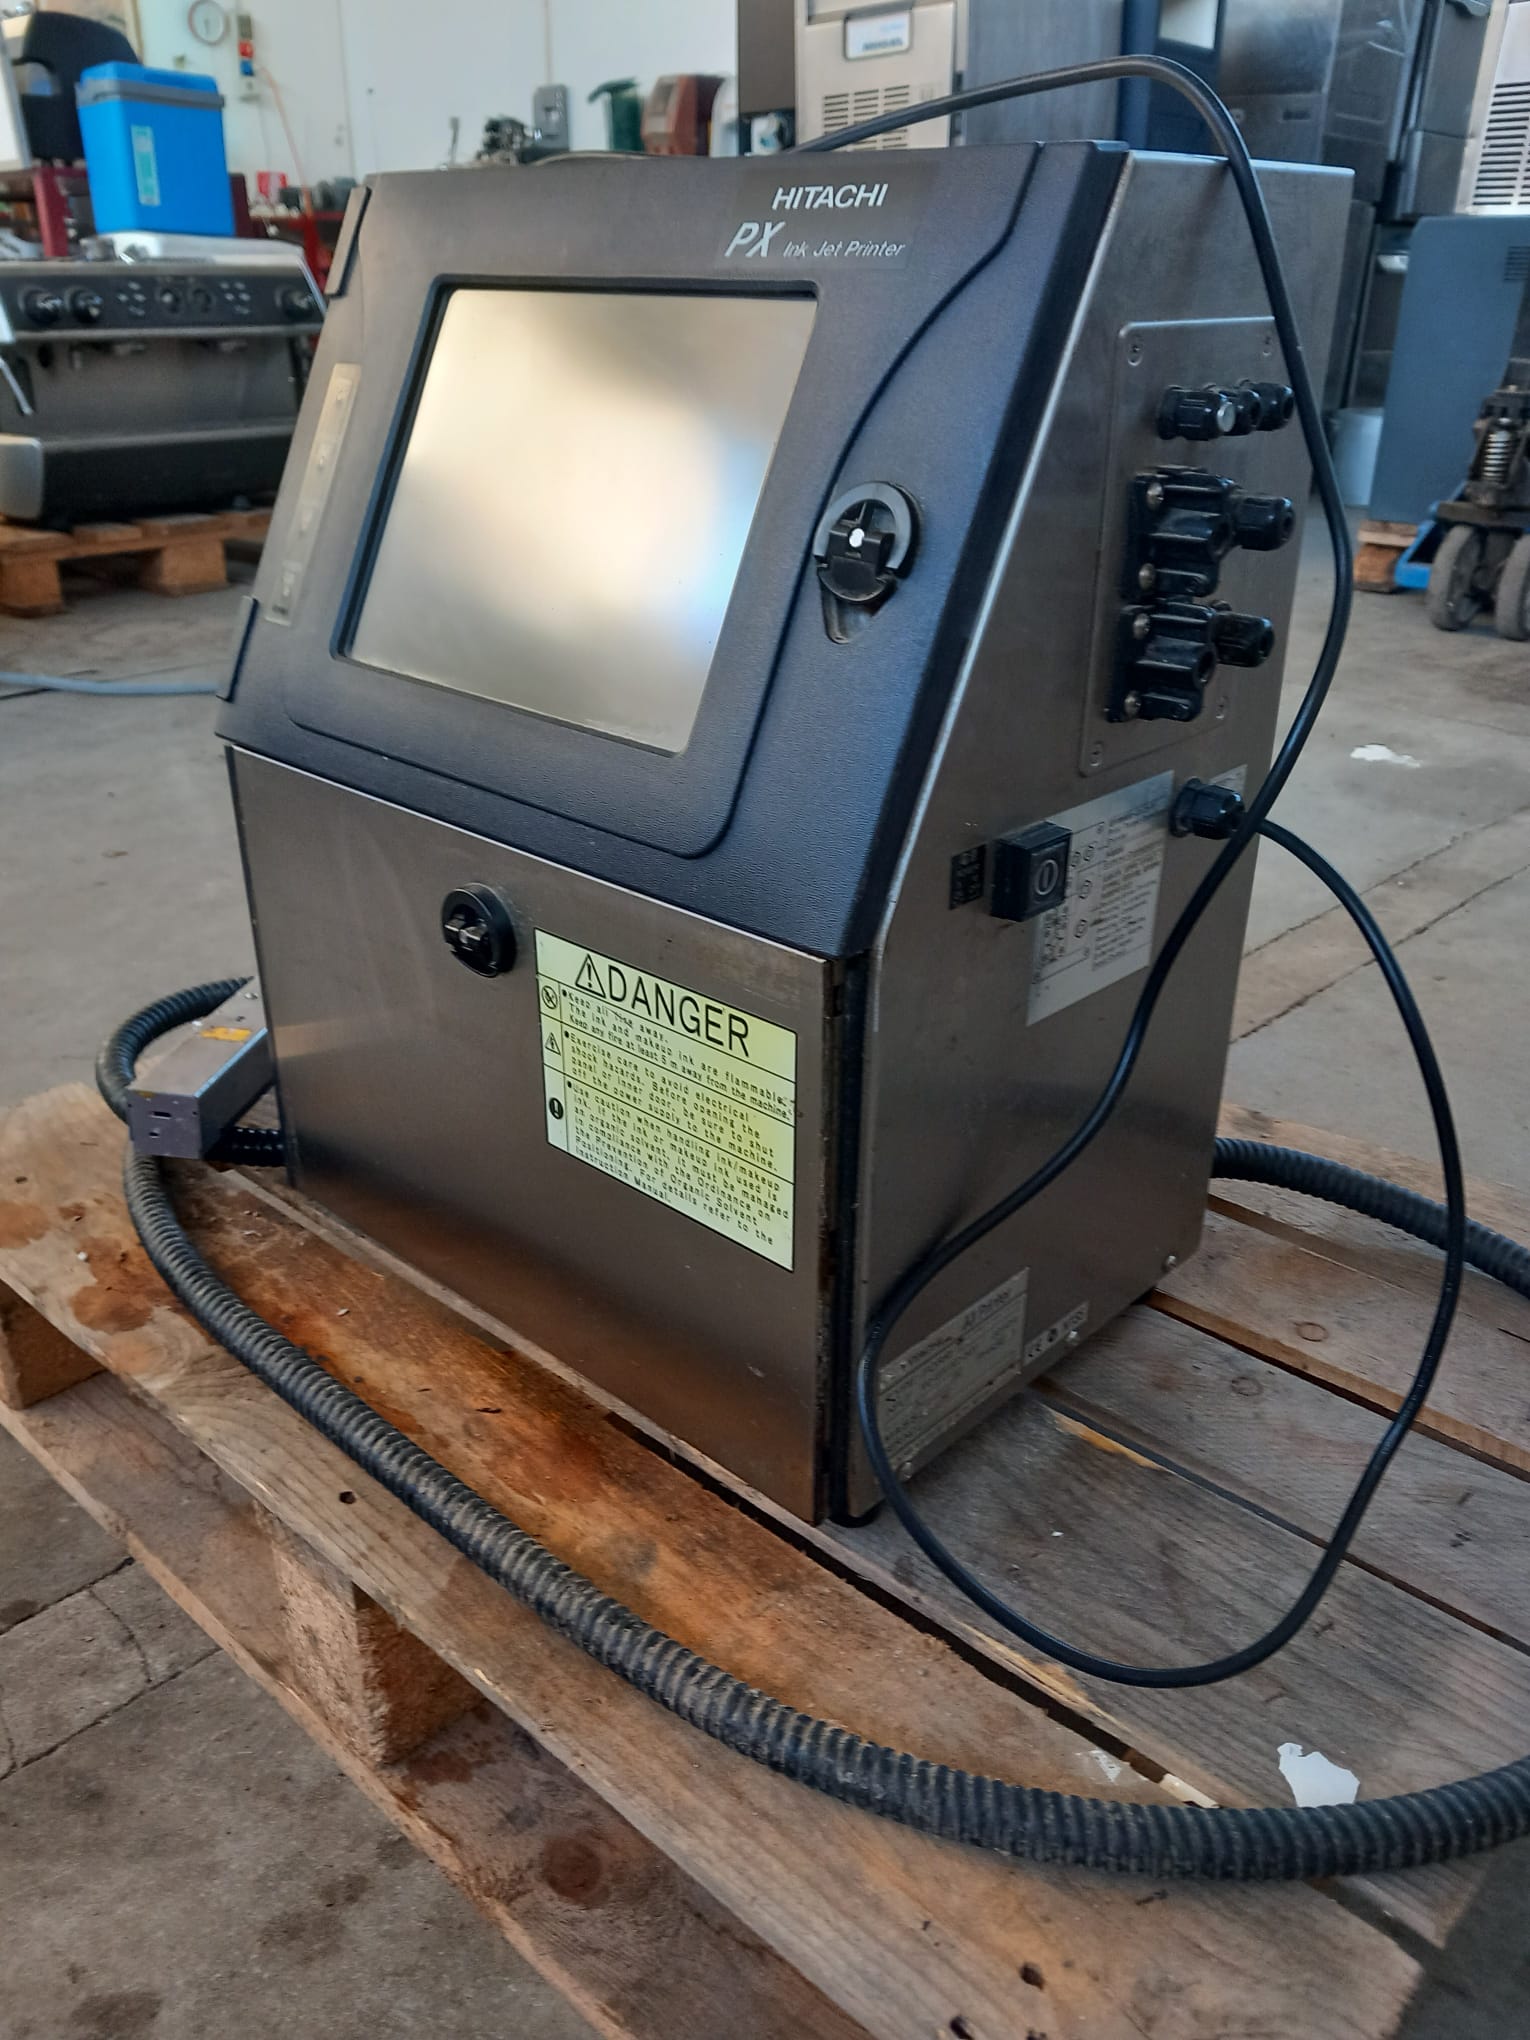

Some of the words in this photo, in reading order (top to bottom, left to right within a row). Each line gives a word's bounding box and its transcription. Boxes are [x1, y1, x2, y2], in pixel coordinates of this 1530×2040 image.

[771, 183, 889, 211] HITACHI
[724, 221, 786, 258] PX
[783, 240, 809, 258] Ink
[813, 240, 842, 258] Jet
[844, 239, 906, 258] Printer
[608, 964, 750, 1057] DANGER
